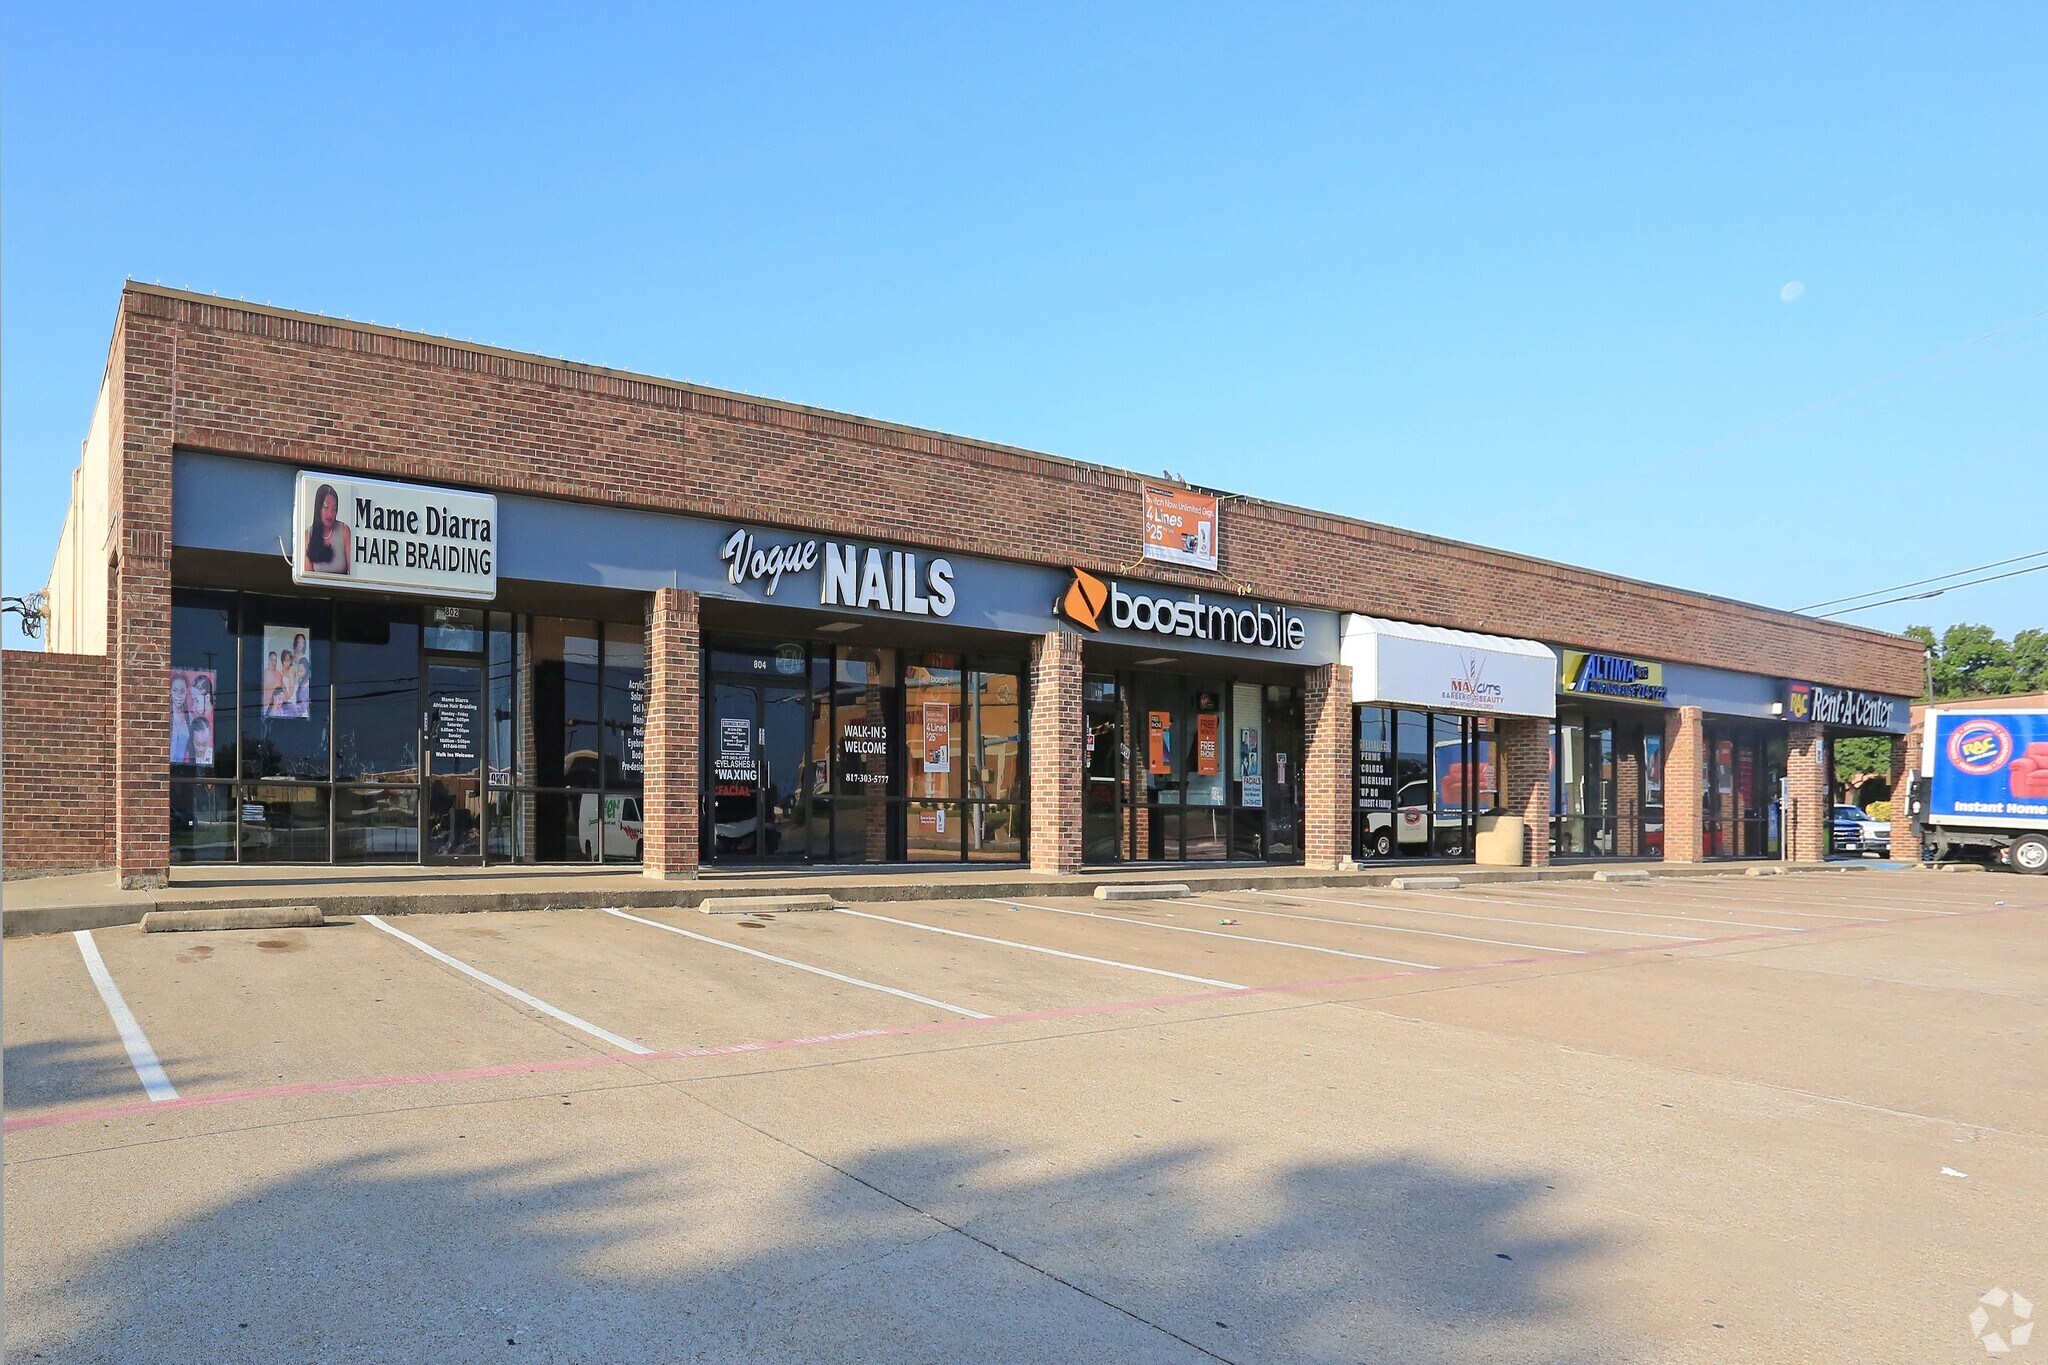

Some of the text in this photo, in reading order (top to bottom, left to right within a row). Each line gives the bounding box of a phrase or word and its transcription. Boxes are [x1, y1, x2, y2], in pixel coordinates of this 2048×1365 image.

[1178, 502, 1202, 514] Unlimited
[354, 497, 492, 543] Mame Diarra
[1146, 506, 1182, 528] 4 Lines
[1146, 522, 1163, 540] $25
[354, 535, 492, 576] HAIR BRAIDING
[722, 528, 956, 618] Vogue NAILS
[445, 606, 459, 618] 802
[754, 660, 767, 670] 804
[1575, 653, 1636, 692] ALTIMA
[930, 675, 950, 684] boost
[630, 692, 643, 701] Solar
[1442, 692, 1504, 704] BARBER BEAUTY
[632, 703, 640, 712] Gel
[1790, 692, 1808, 718] RAC
[931, 723, 947, 732] Lines
[844, 741, 886, 754] WELCOME
[1200, 740, 1215, 750] FREE
[1962, 737, 1995, 756] RAC
[632, 750, 644, 761] Body
[716, 760, 750, 768] EYELASHES
[1361, 764, 1384, 774] COLORS
[718, 769, 758, 780] WAXING
[845, 773, 889, 784] 817-303-5777
[1360, 776, 1392, 786] HIGHLIGHT
[719, 786, 749, 796] FACIAL
[1954, 800, 2048, 814] Instant Home
